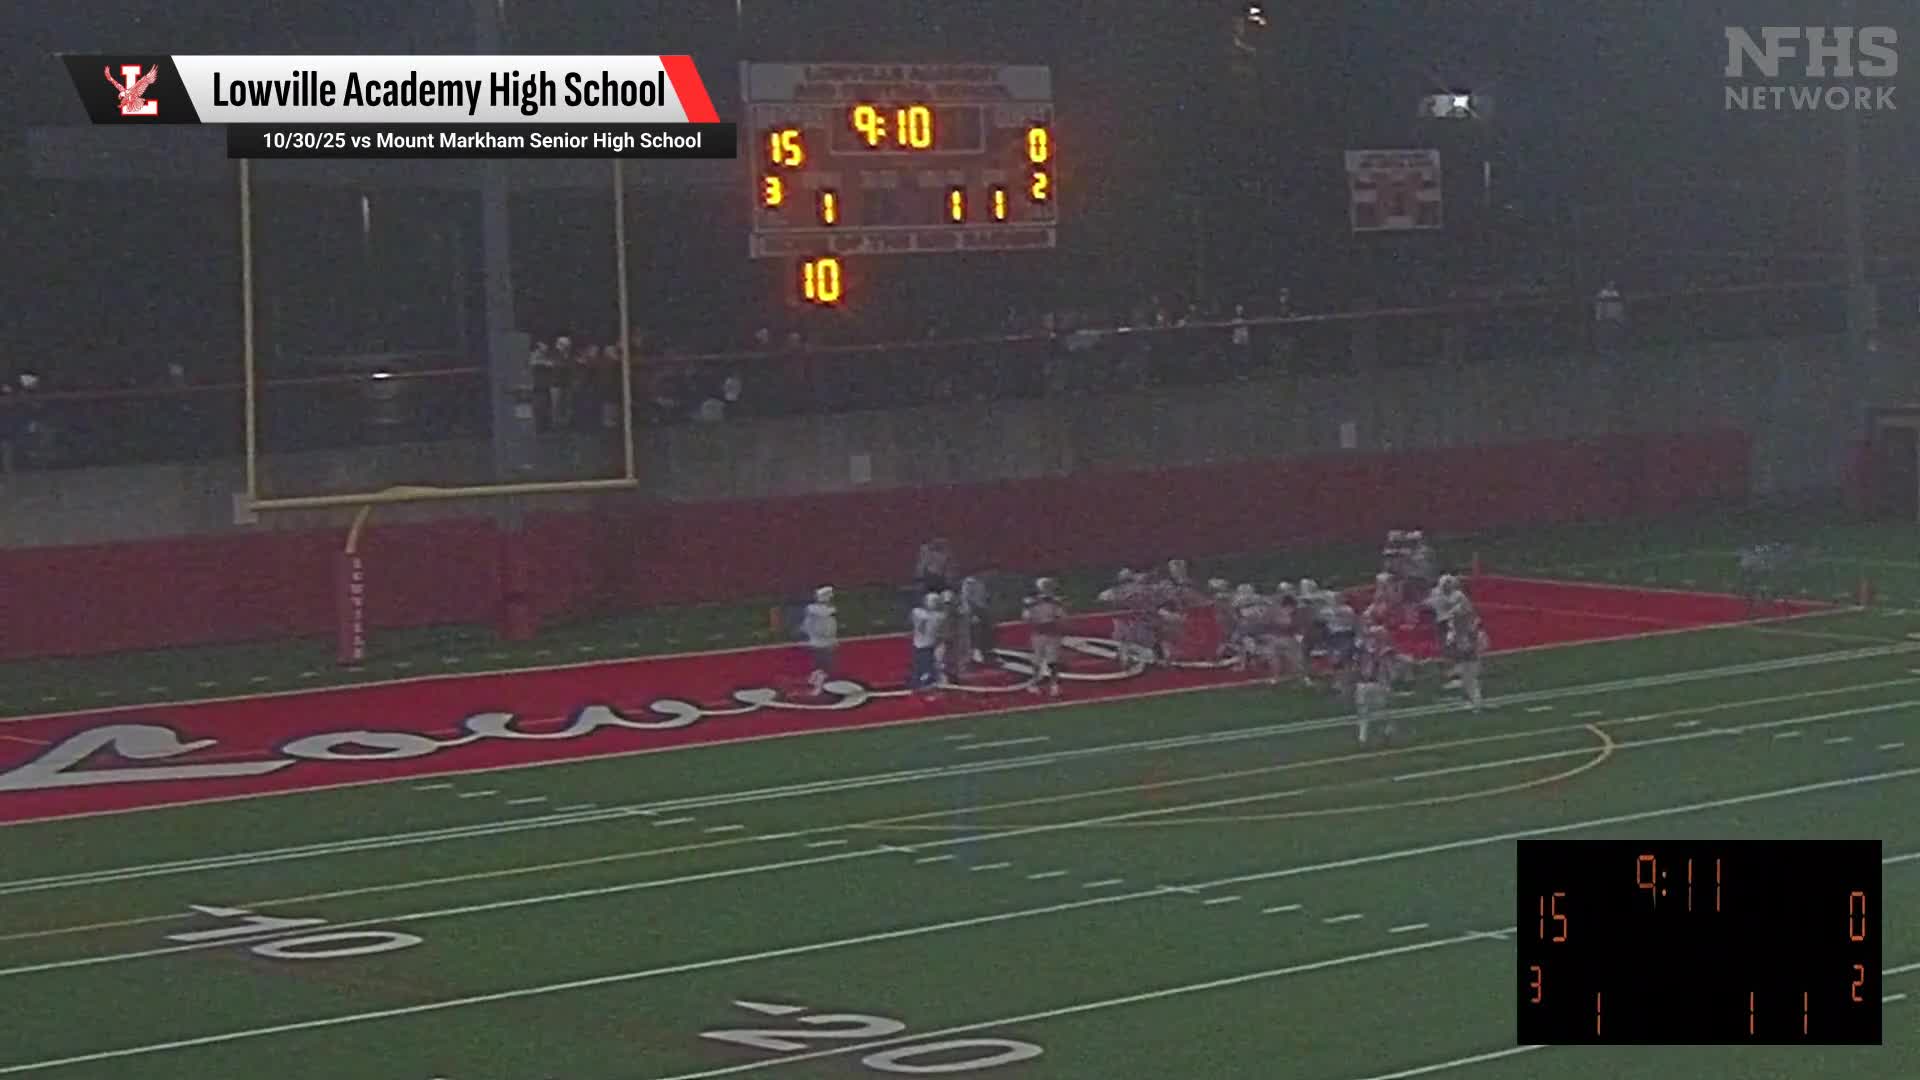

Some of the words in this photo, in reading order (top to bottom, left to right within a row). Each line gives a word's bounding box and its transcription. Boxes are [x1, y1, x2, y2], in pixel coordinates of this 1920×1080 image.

[853, 105, 931, 150] 9:10
[769, 129, 803, 167] 15
[1028, 127, 1049, 163] 0
[763, 176, 784, 205] 3
[1031, 172, 1049, 200] 2
[823, 193, 836, 224] 1
[951, 189, 962, 221] 1
[994, 189, 1005, 220] 1
[803, 258, 842, 302] 10
[698, 1014, 1044, 1073] 20
